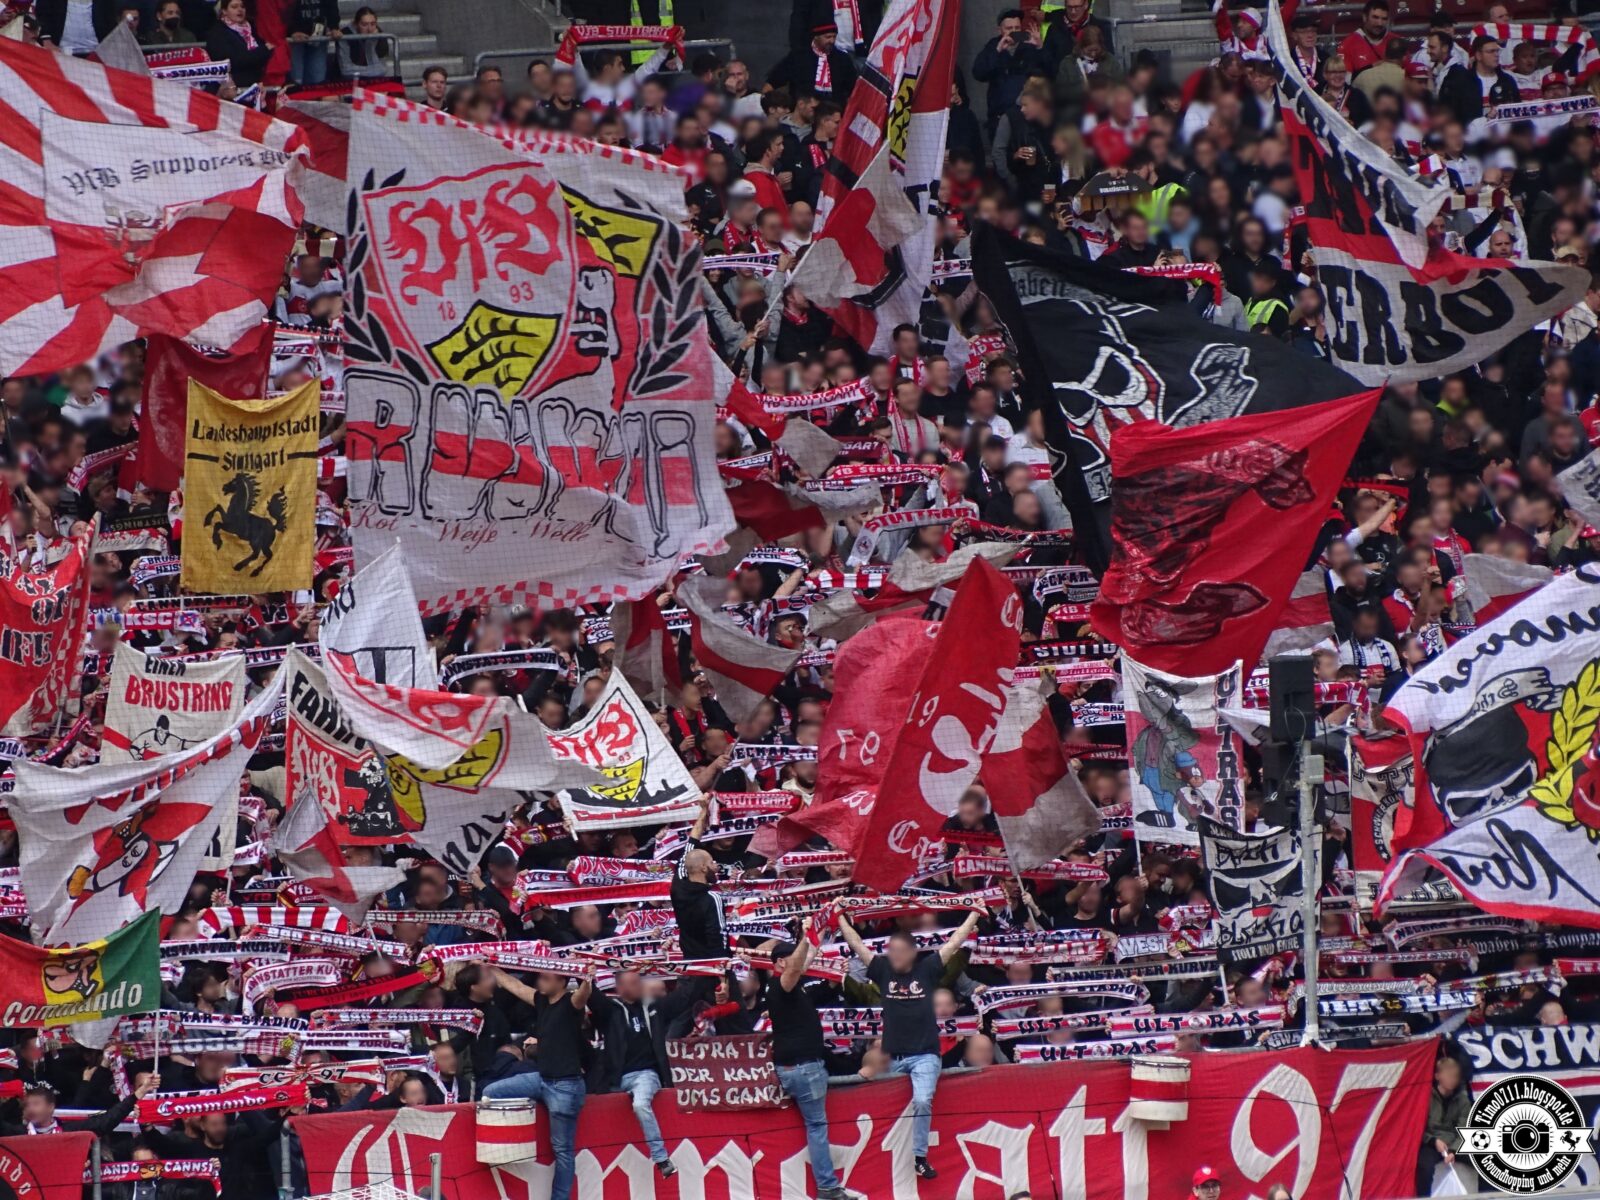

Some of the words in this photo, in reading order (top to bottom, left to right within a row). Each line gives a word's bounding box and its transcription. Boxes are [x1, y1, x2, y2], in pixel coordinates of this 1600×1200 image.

[605, 25, 669, 37] STUTTGART
[438, 301, 457, 321] 18
[509, 281, 535, 304] 93
[221, 448, 287, 474] Stuttgart
[353, 501, 399, 533] Rot
[529, 518, 592, 545] Welle
[124, 611, 174, 627] KSC
[144, 654, 187, 677] EINEN
[124, 674, 235, 713] BRUSTRING
[617, 752, 632, 765] 93
[288, 883, 314, 895] VfB
[754, 907, 772, 917] IST
[775, 904, 802, 915] DER
[241, 940, 290, 955] KURVE
[2, 980, 143, 1028] Commando
[241, 1014, 309, 1031] STADION
[258, 1071, 286, 1086] CC
[320, 1067, 348, 1083] 97
[671, 1065, 718, 1085] DER
[156, 1094, 267, 1118] Commando
[676, 1087, 722, 1109] UMS
